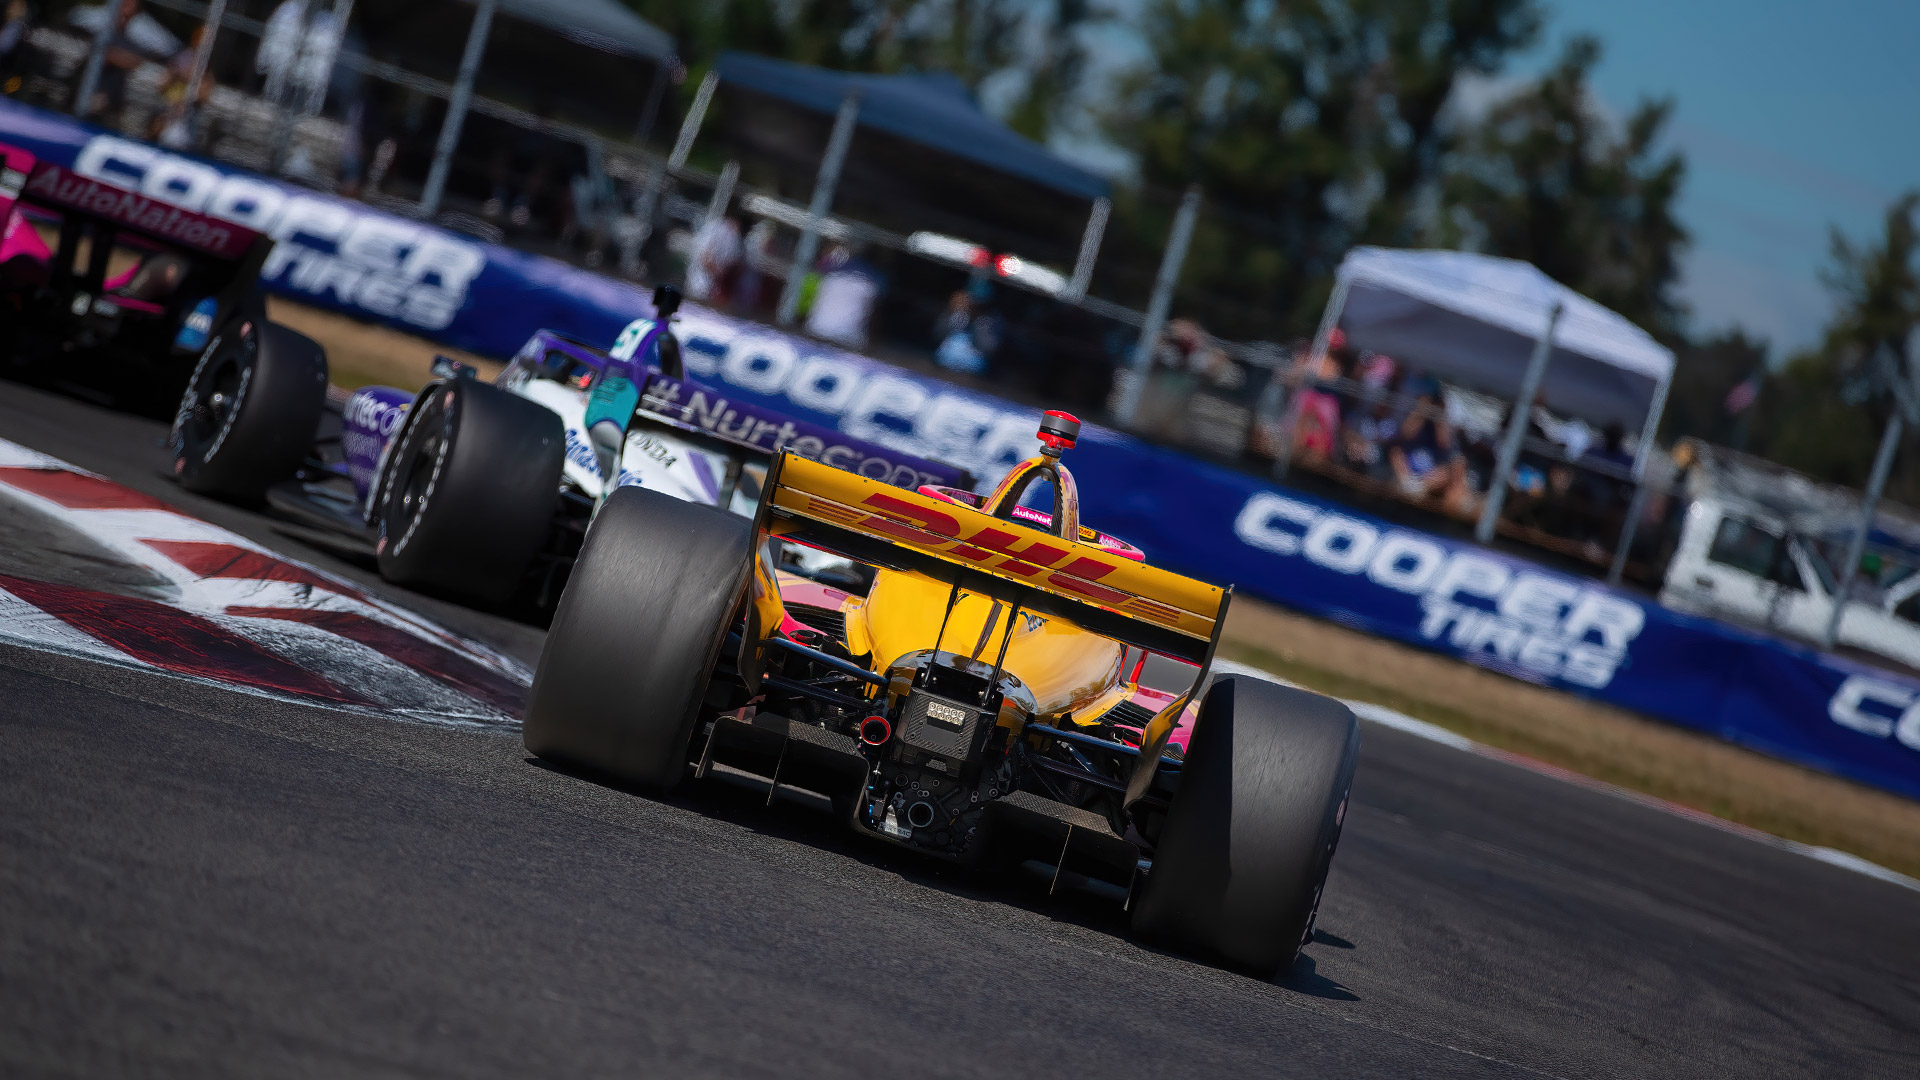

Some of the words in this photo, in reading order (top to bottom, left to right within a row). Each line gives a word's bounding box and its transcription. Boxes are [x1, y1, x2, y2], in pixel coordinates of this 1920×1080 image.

[32, 166, 231, 250] AutoNation
[73, 135, 486, 292] COOPER
[261, 243, 460, 332] TIRES
[859, 492, 1131, 604] DHL
[1011, 506, 1053, 527] AutoNat
[1235, 491, 1647, 645] COOPER
[1418, 600, 1625, 690] TIRES
